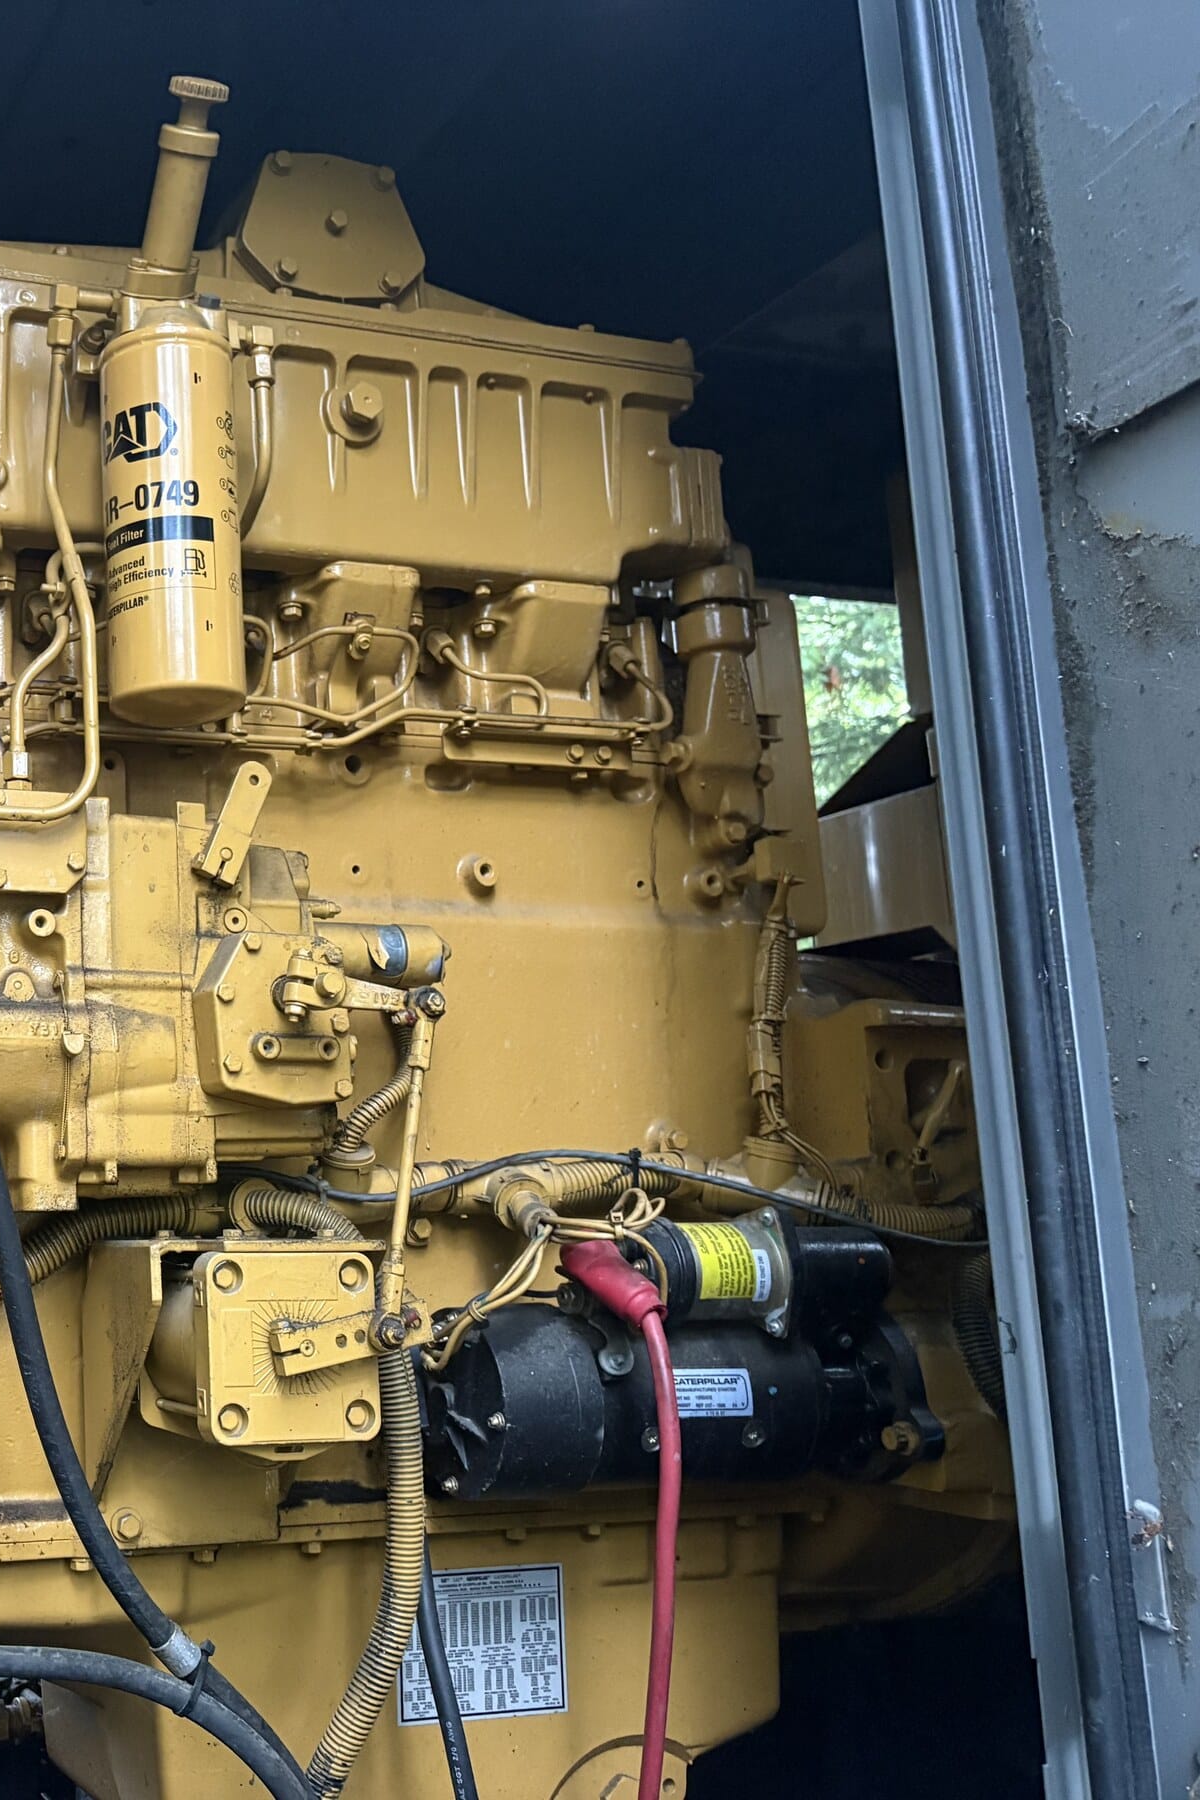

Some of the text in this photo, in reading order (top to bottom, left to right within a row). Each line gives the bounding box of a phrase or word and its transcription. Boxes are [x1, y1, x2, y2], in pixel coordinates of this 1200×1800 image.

[105, 479, 200, 528] 1R-0749
[120, 528, 144, 545] Filter
[123, 567, 174, 585] Efficiency
[445, 1721, 455, 1742] AWG
